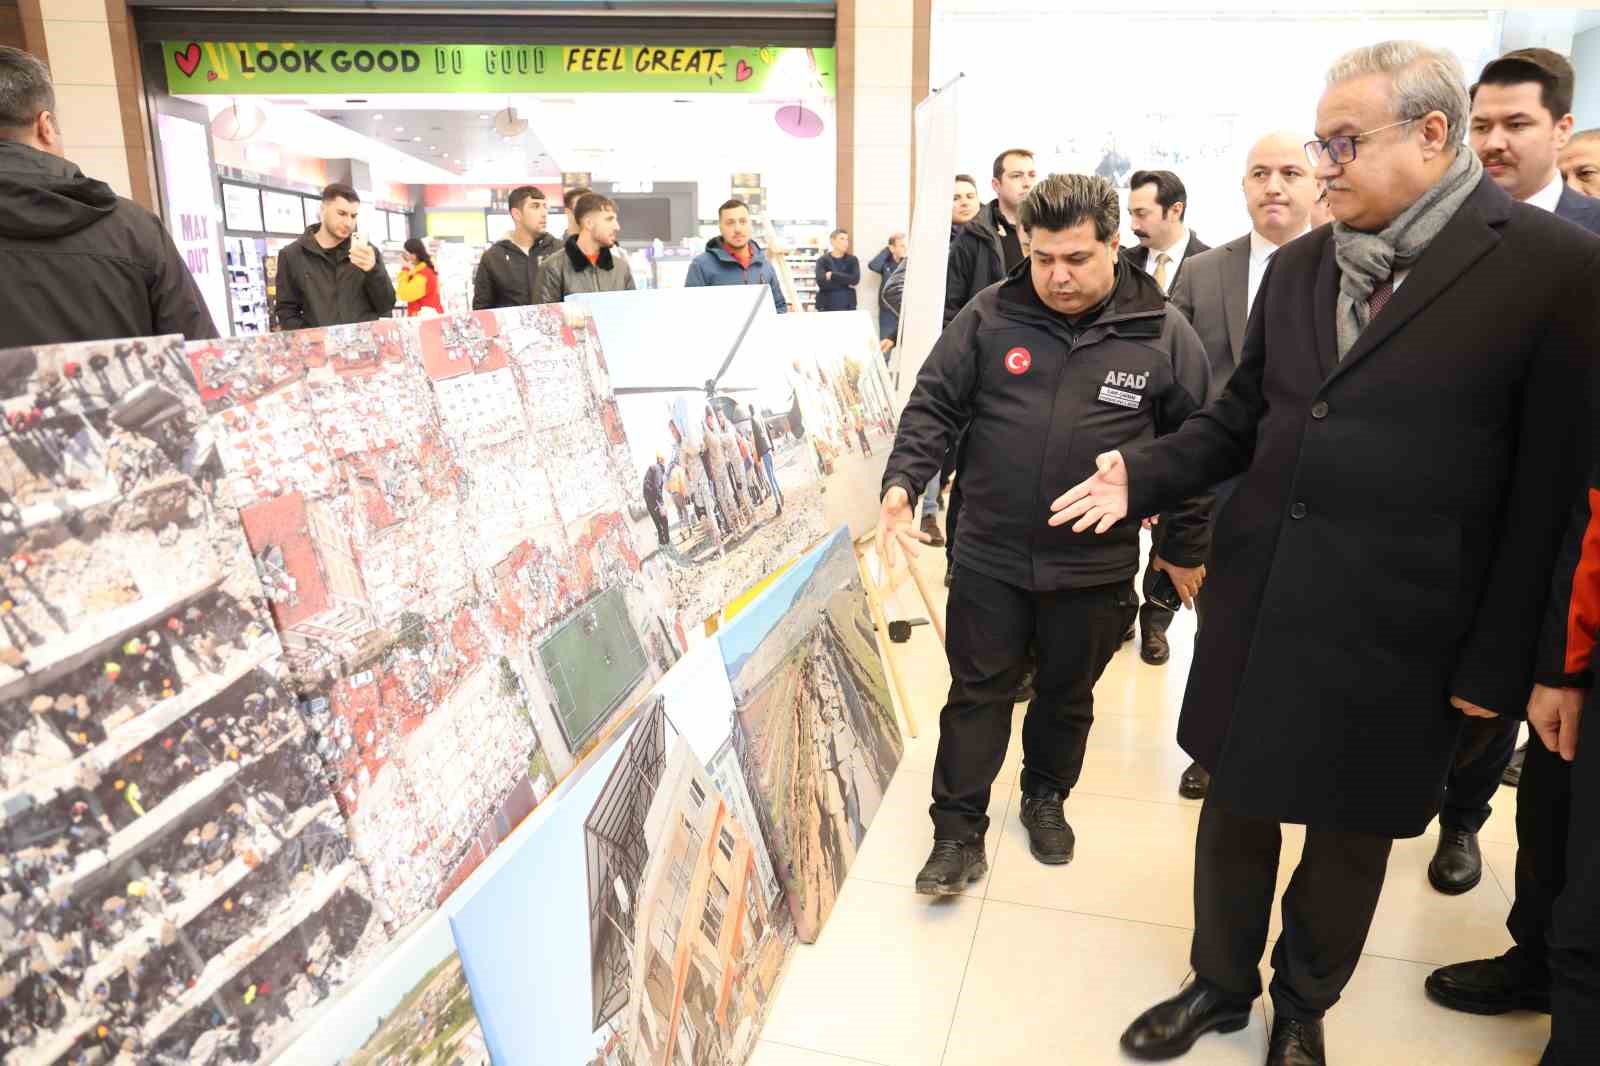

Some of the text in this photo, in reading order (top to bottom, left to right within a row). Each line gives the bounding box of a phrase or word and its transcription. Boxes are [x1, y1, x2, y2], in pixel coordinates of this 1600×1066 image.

[239, 47, 723, 74] LOOK GOOD DO GOOD FEEL GREAT
[180, 213, 208, 241] MAX
[187, 247, 209, 274] OUT
[1104, 370, 1147, 390] AFAD
